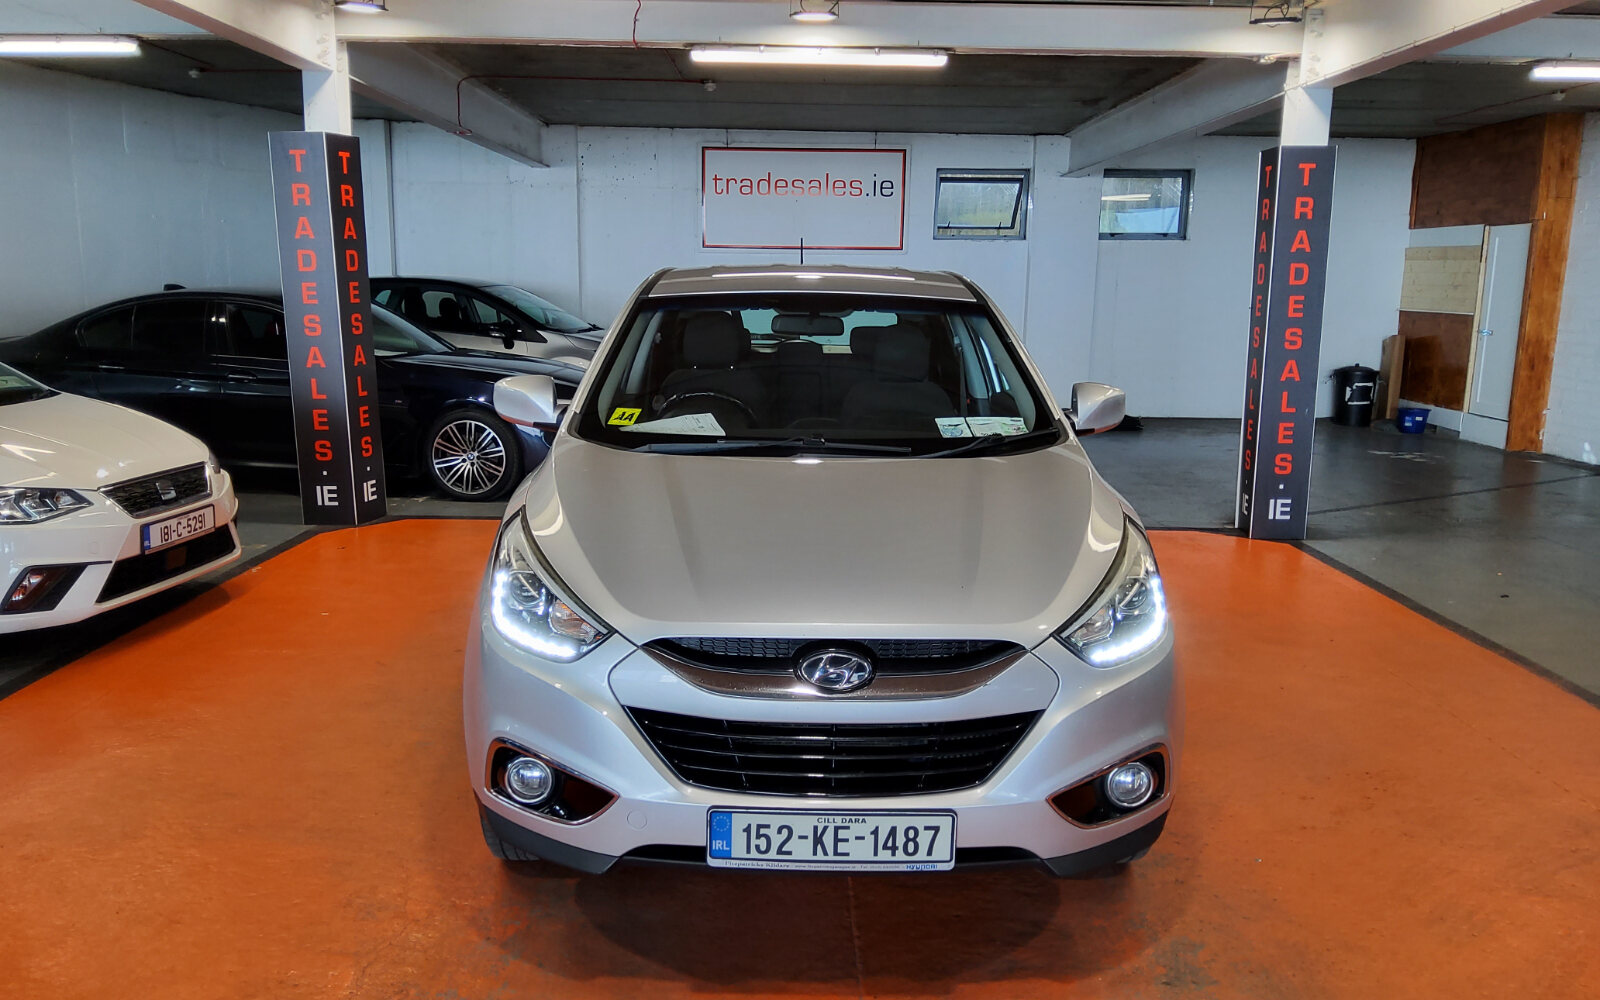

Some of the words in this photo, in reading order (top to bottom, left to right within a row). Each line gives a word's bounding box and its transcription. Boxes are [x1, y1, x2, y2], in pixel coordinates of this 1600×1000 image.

[712, 171, 895, 198] tradesales.ie
[613, 411, 636, 422] AA
[160, 512, 206, 544] 181-C-5291
[712, 839, 730, 851] IRL
[742, 823, 941, 857] 152-KE-1487
